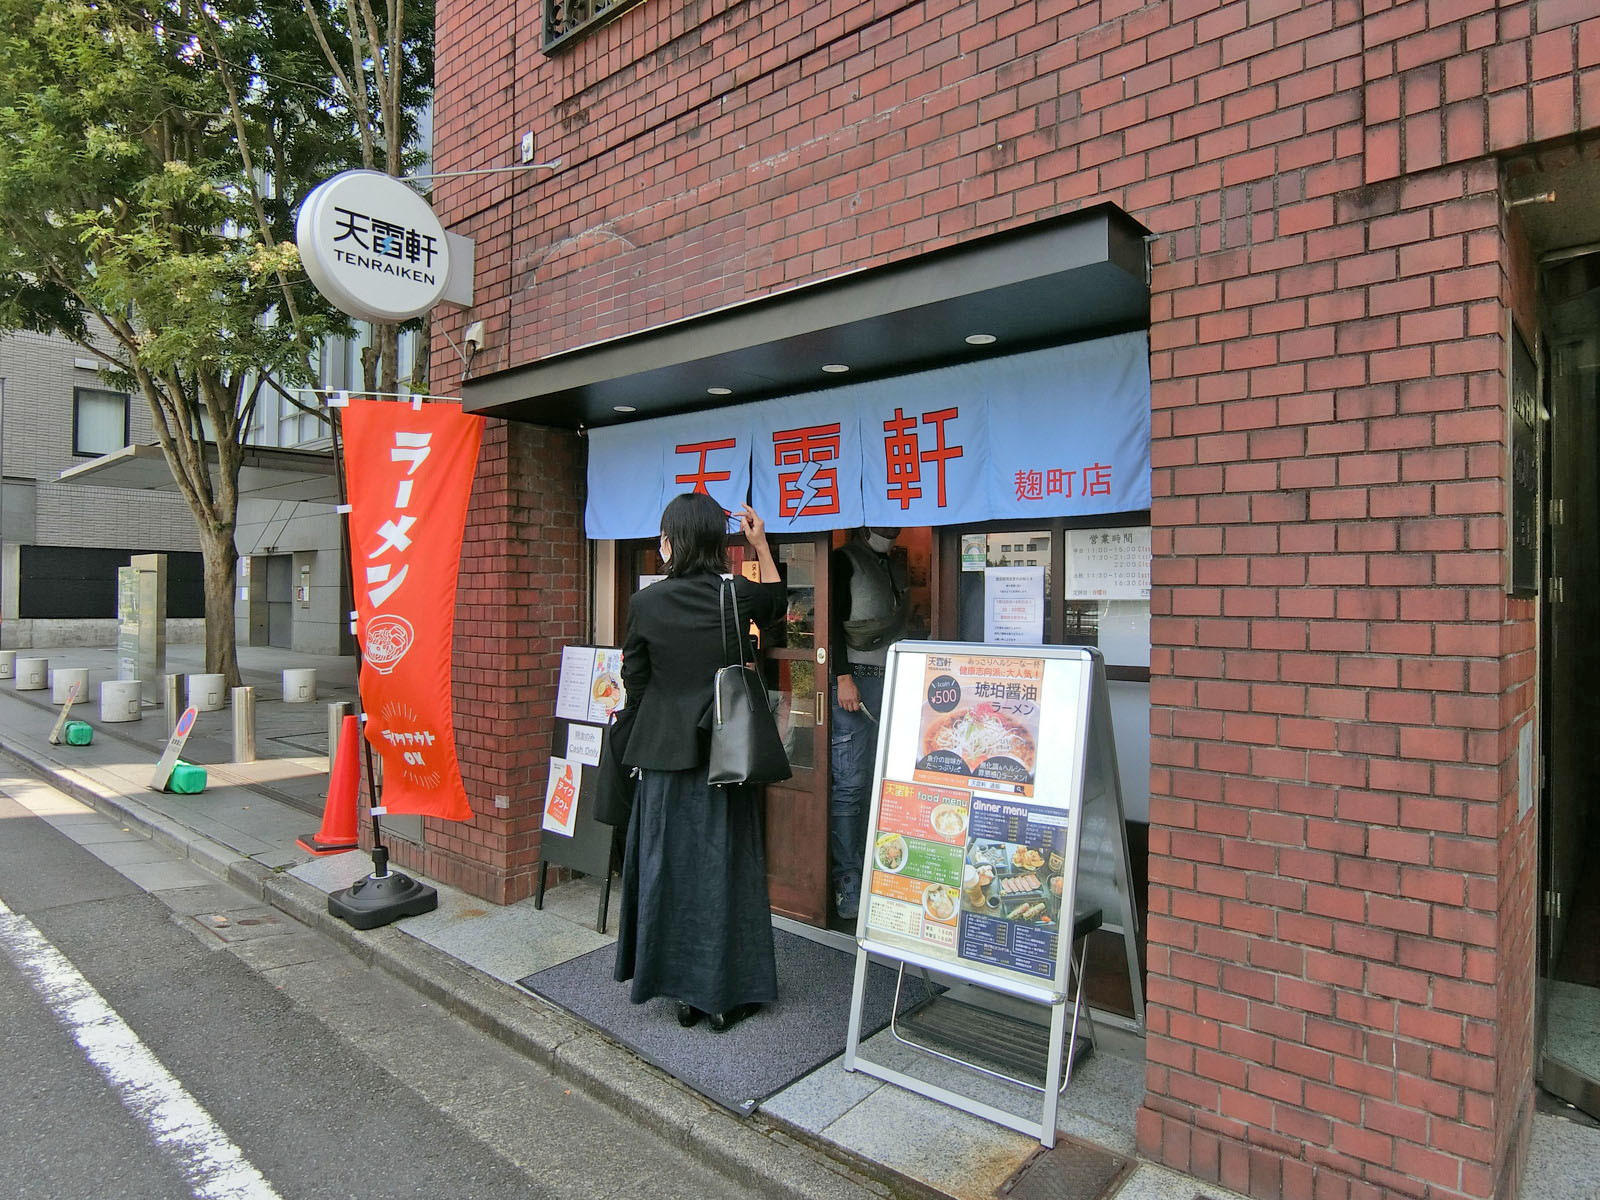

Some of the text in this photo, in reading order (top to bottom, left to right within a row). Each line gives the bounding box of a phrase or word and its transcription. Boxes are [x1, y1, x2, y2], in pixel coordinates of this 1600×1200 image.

[333, 206, 438, 268] 天雷軒
[333, 248, 435, 286] TENRAIKEN
[675, 407, 964, 522] 天雷軒
[1014, 463, 1114, 502] 麹町店
[366, 431, 433, 609] ラーメン
[1089, 533, 1133, 545] 営業時間
[930, 689, 957, 704] ¥500
[974, 681, 1038, 701] 琥珀醤油
[991, 701, 1034, 715] ラーメン
[569, 744, 584, 753] Cash
[557, 781, 574, 797] テイク
[553, 795, 569, 811] アウト
[973, 800, 1002, 813] dinner
[1002, 806, 1028, 817] menu
